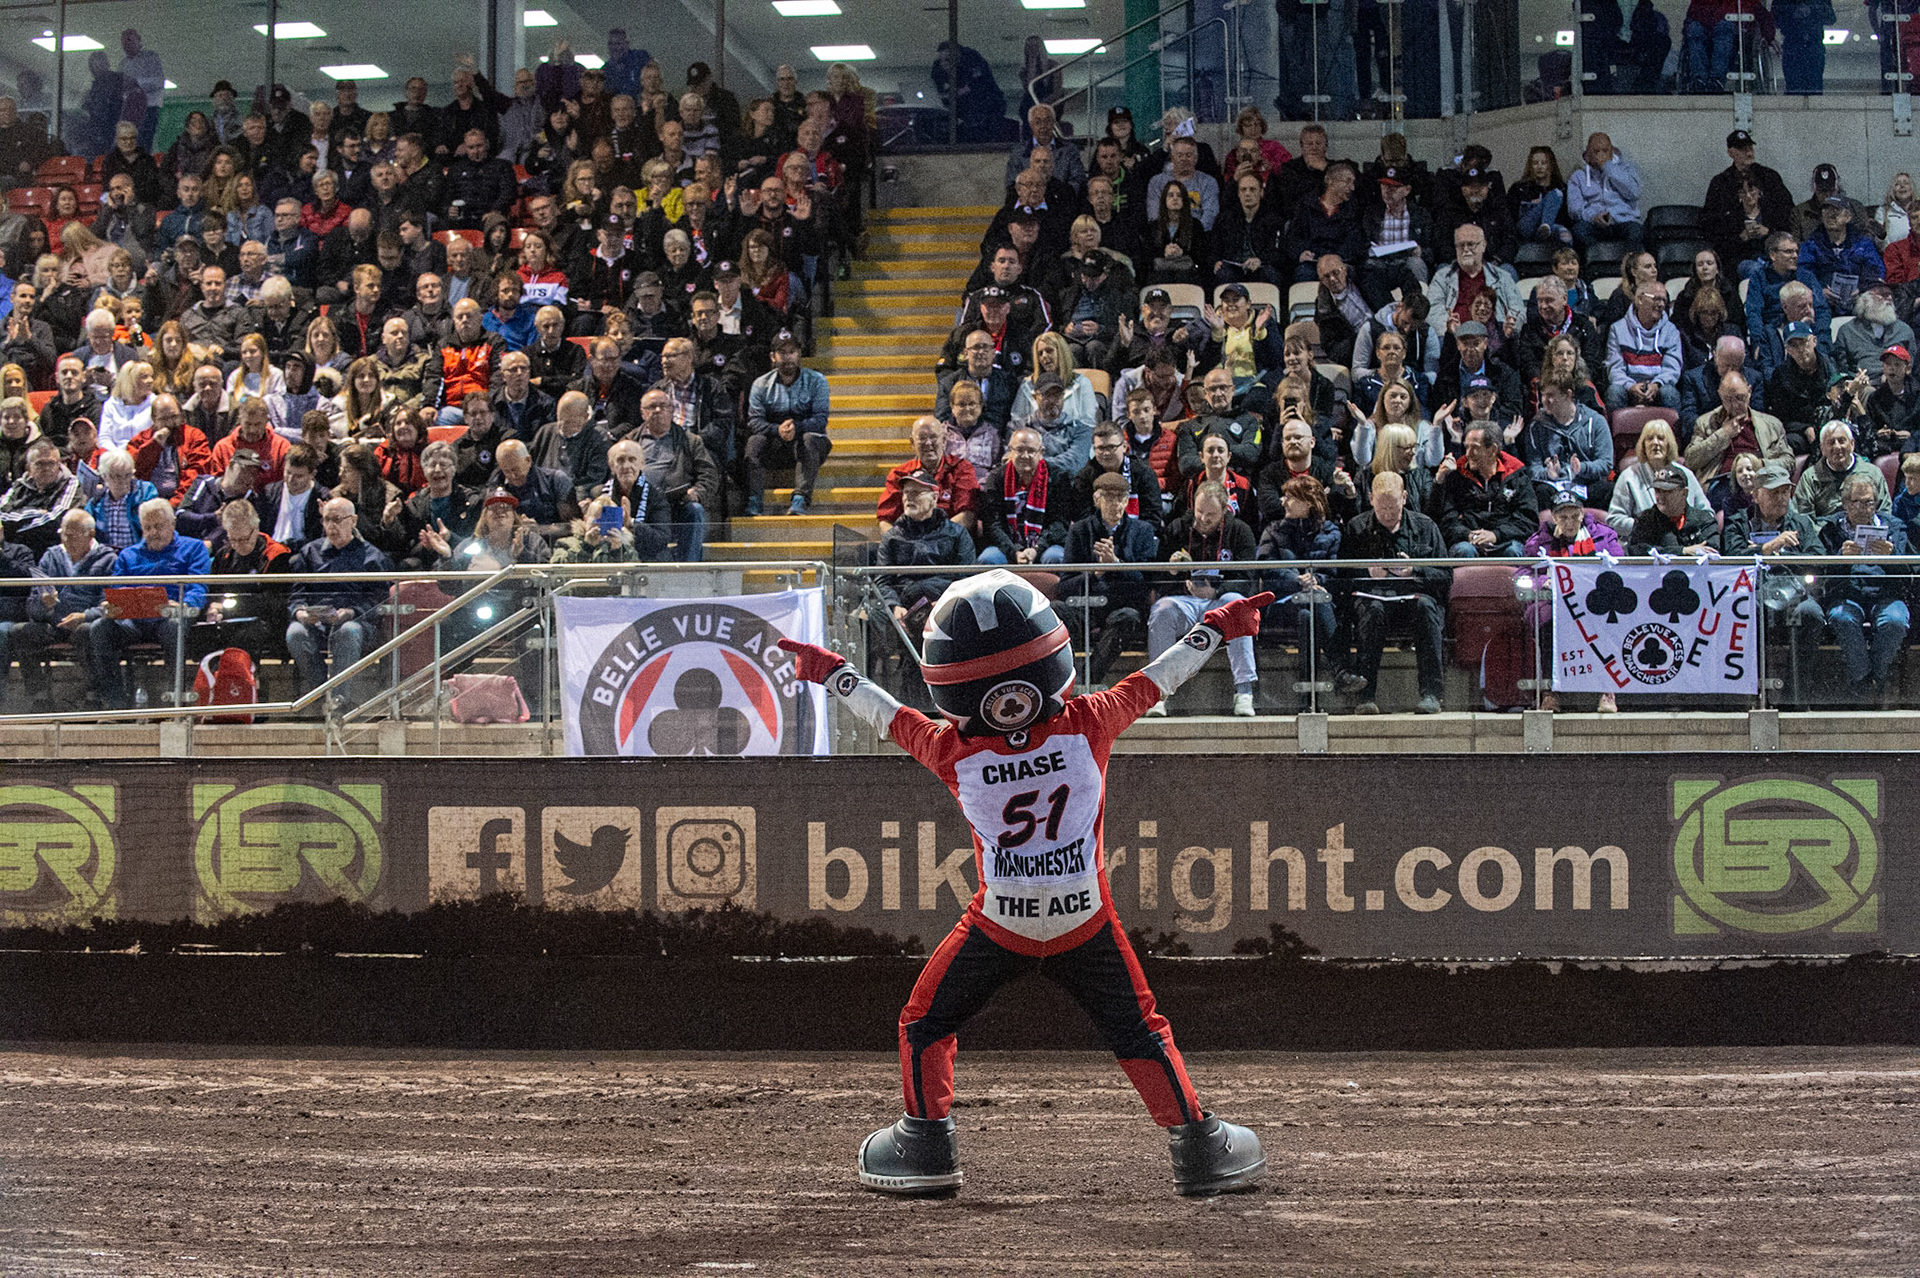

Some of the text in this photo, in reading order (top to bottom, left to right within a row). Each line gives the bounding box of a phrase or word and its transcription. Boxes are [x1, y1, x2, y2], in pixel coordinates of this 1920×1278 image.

[1555, 565, 1753, 689] BELLE VUE ACES
[1624, 624, 1684, 661] BELLE VUE ACES
[592, 614, 805, 707] BELLE VUE ACES
[1561, 649, 1585, 661] EST
[1563, 664, 1593, 677] 1928
[1624, 654, 1679, 684] MANCHESTER
[985, 685, 1036, 710] BELLE VUE ACES
[982, 750, 1067, 785] CHASE
[991, 837, 1086, 878] MANCHESTER
[996, 889, 1092, 918] THE ACE
